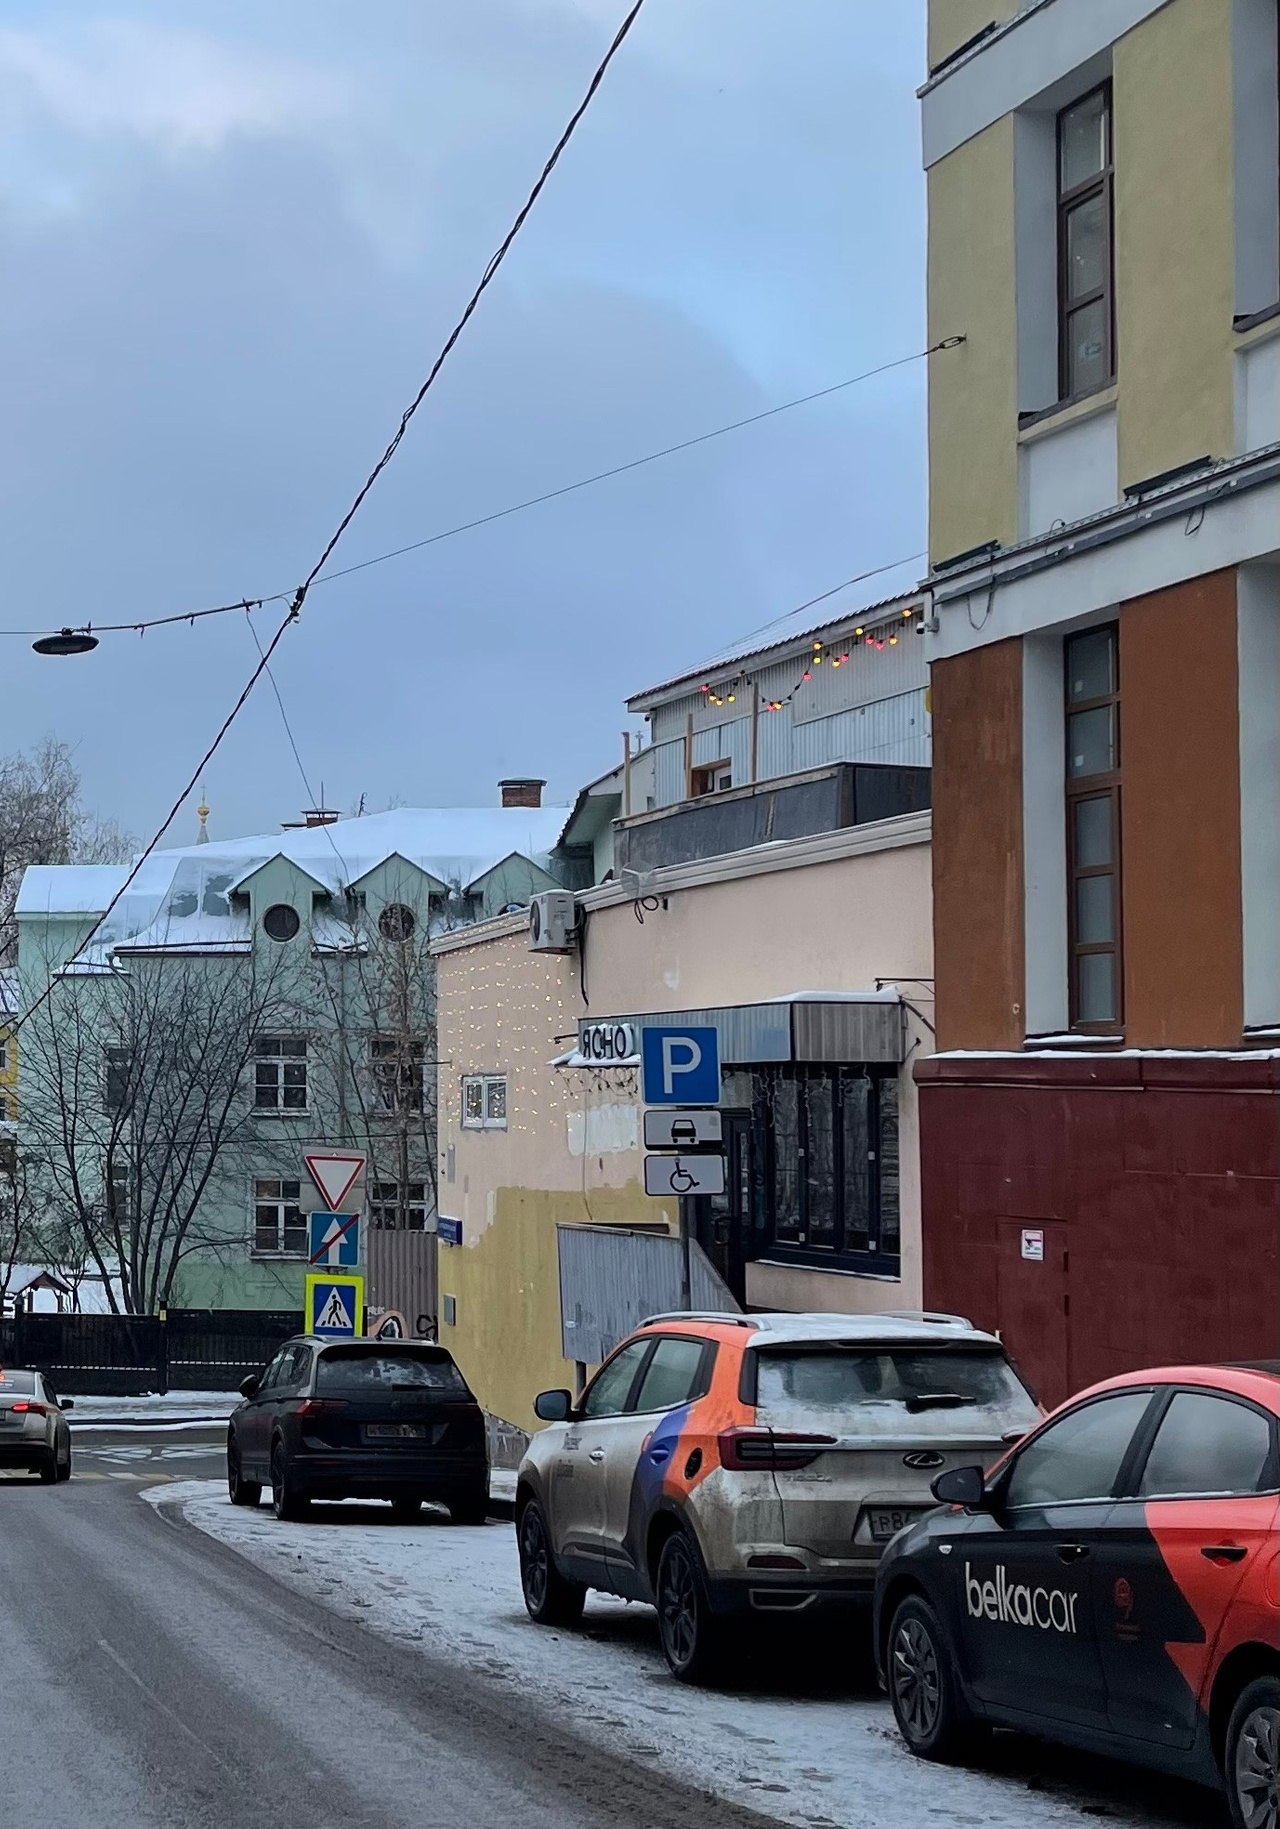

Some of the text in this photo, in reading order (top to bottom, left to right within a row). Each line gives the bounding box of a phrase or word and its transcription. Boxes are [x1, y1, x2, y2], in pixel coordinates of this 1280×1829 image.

[582, 1025, 627, 1060] ЯСНО
[661, 1036, 702, 1094] P
[965, 1561, 1078, 1633] belkacar
